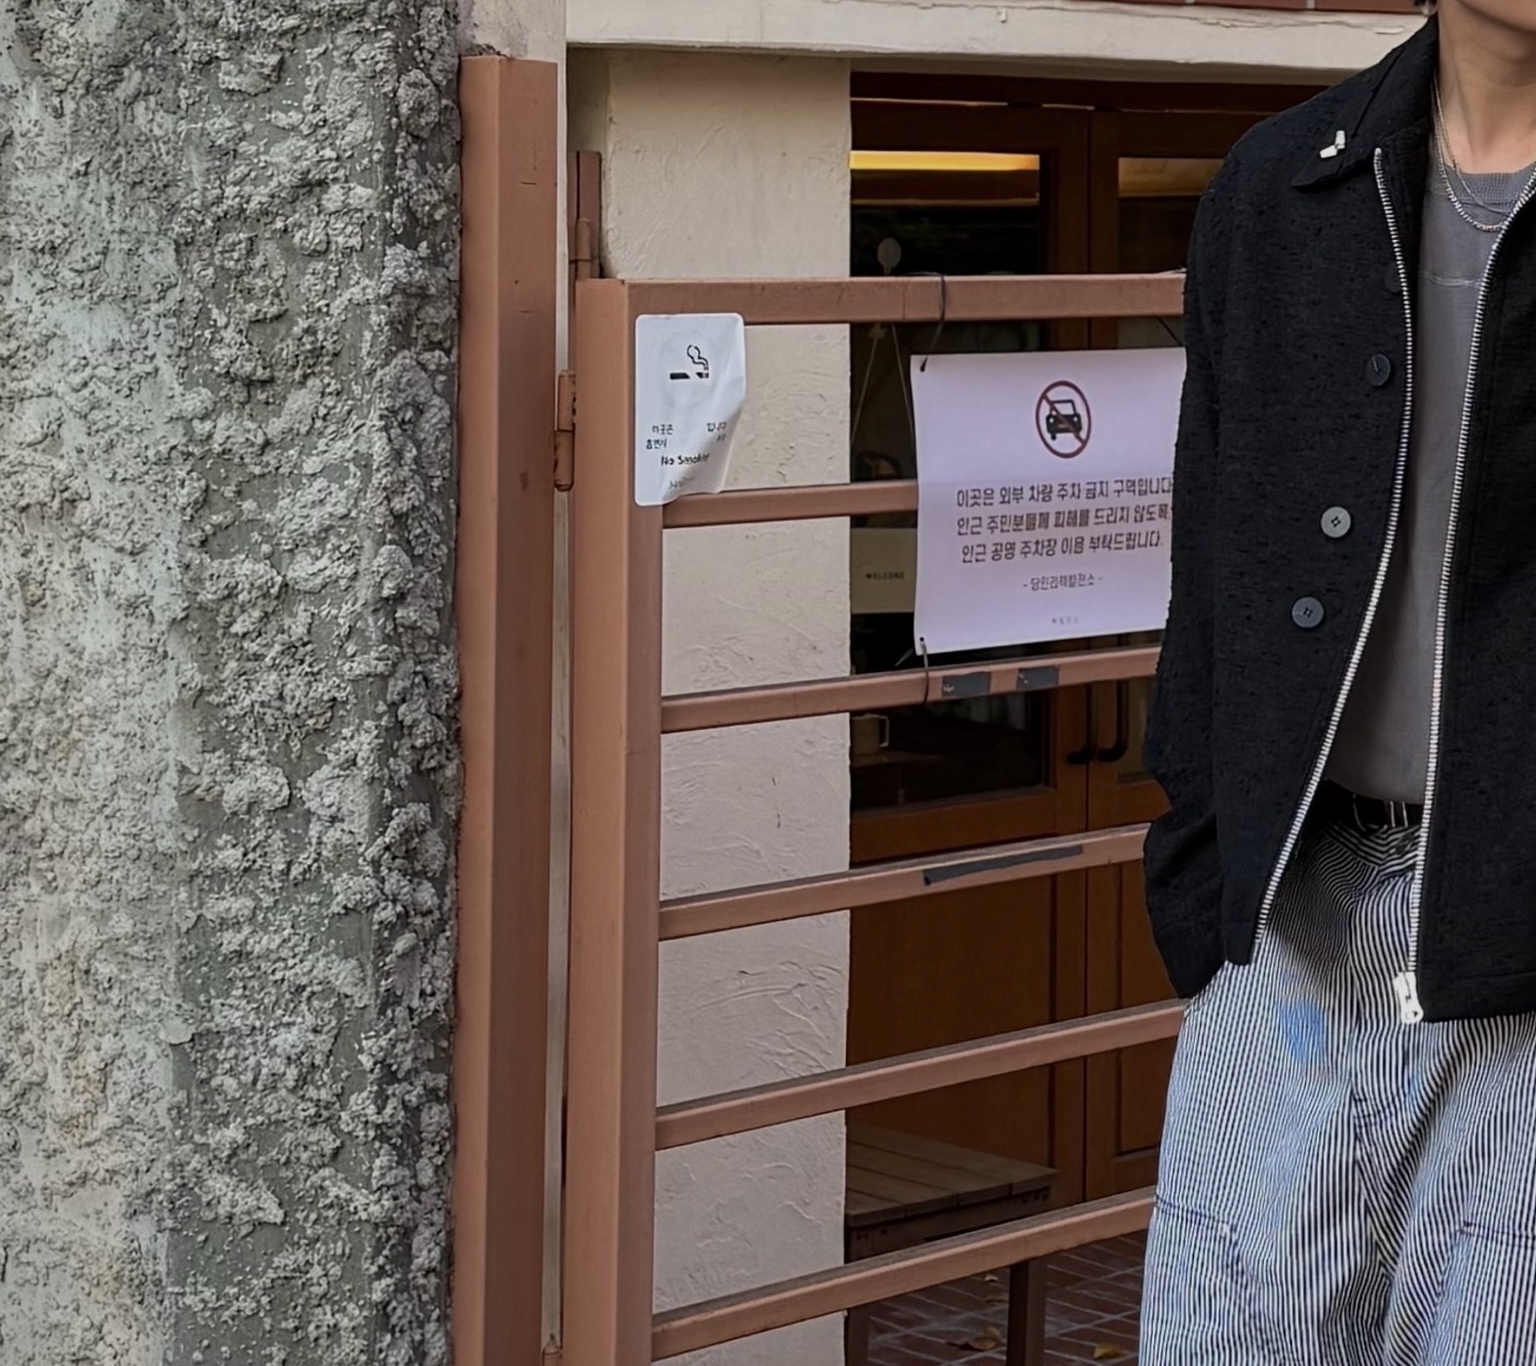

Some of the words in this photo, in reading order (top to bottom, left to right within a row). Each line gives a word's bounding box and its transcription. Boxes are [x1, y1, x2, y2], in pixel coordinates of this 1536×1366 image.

[956, 486, 995, 508] 이곳은
[999, 485, 1025, 505] 외부
[1028, 483, 1054, 504] 차량
[1057, 482, 1082, 502] 주차
[1085, 481, 1110, 500] 금지
[957, 515, 983, 537] 인근
[986, 510, 1050, 535] 주민분들께
[1053, 508, 1091, 529] 피해를
[1093, 505, 1130, 527] 드리지
[961, 542, 987, 564] 인근
[990, 540, 1017, 562] 공영
[1019, 537, 1058, 558] 주차장
[1060, 535, 1085, 555] 이용
